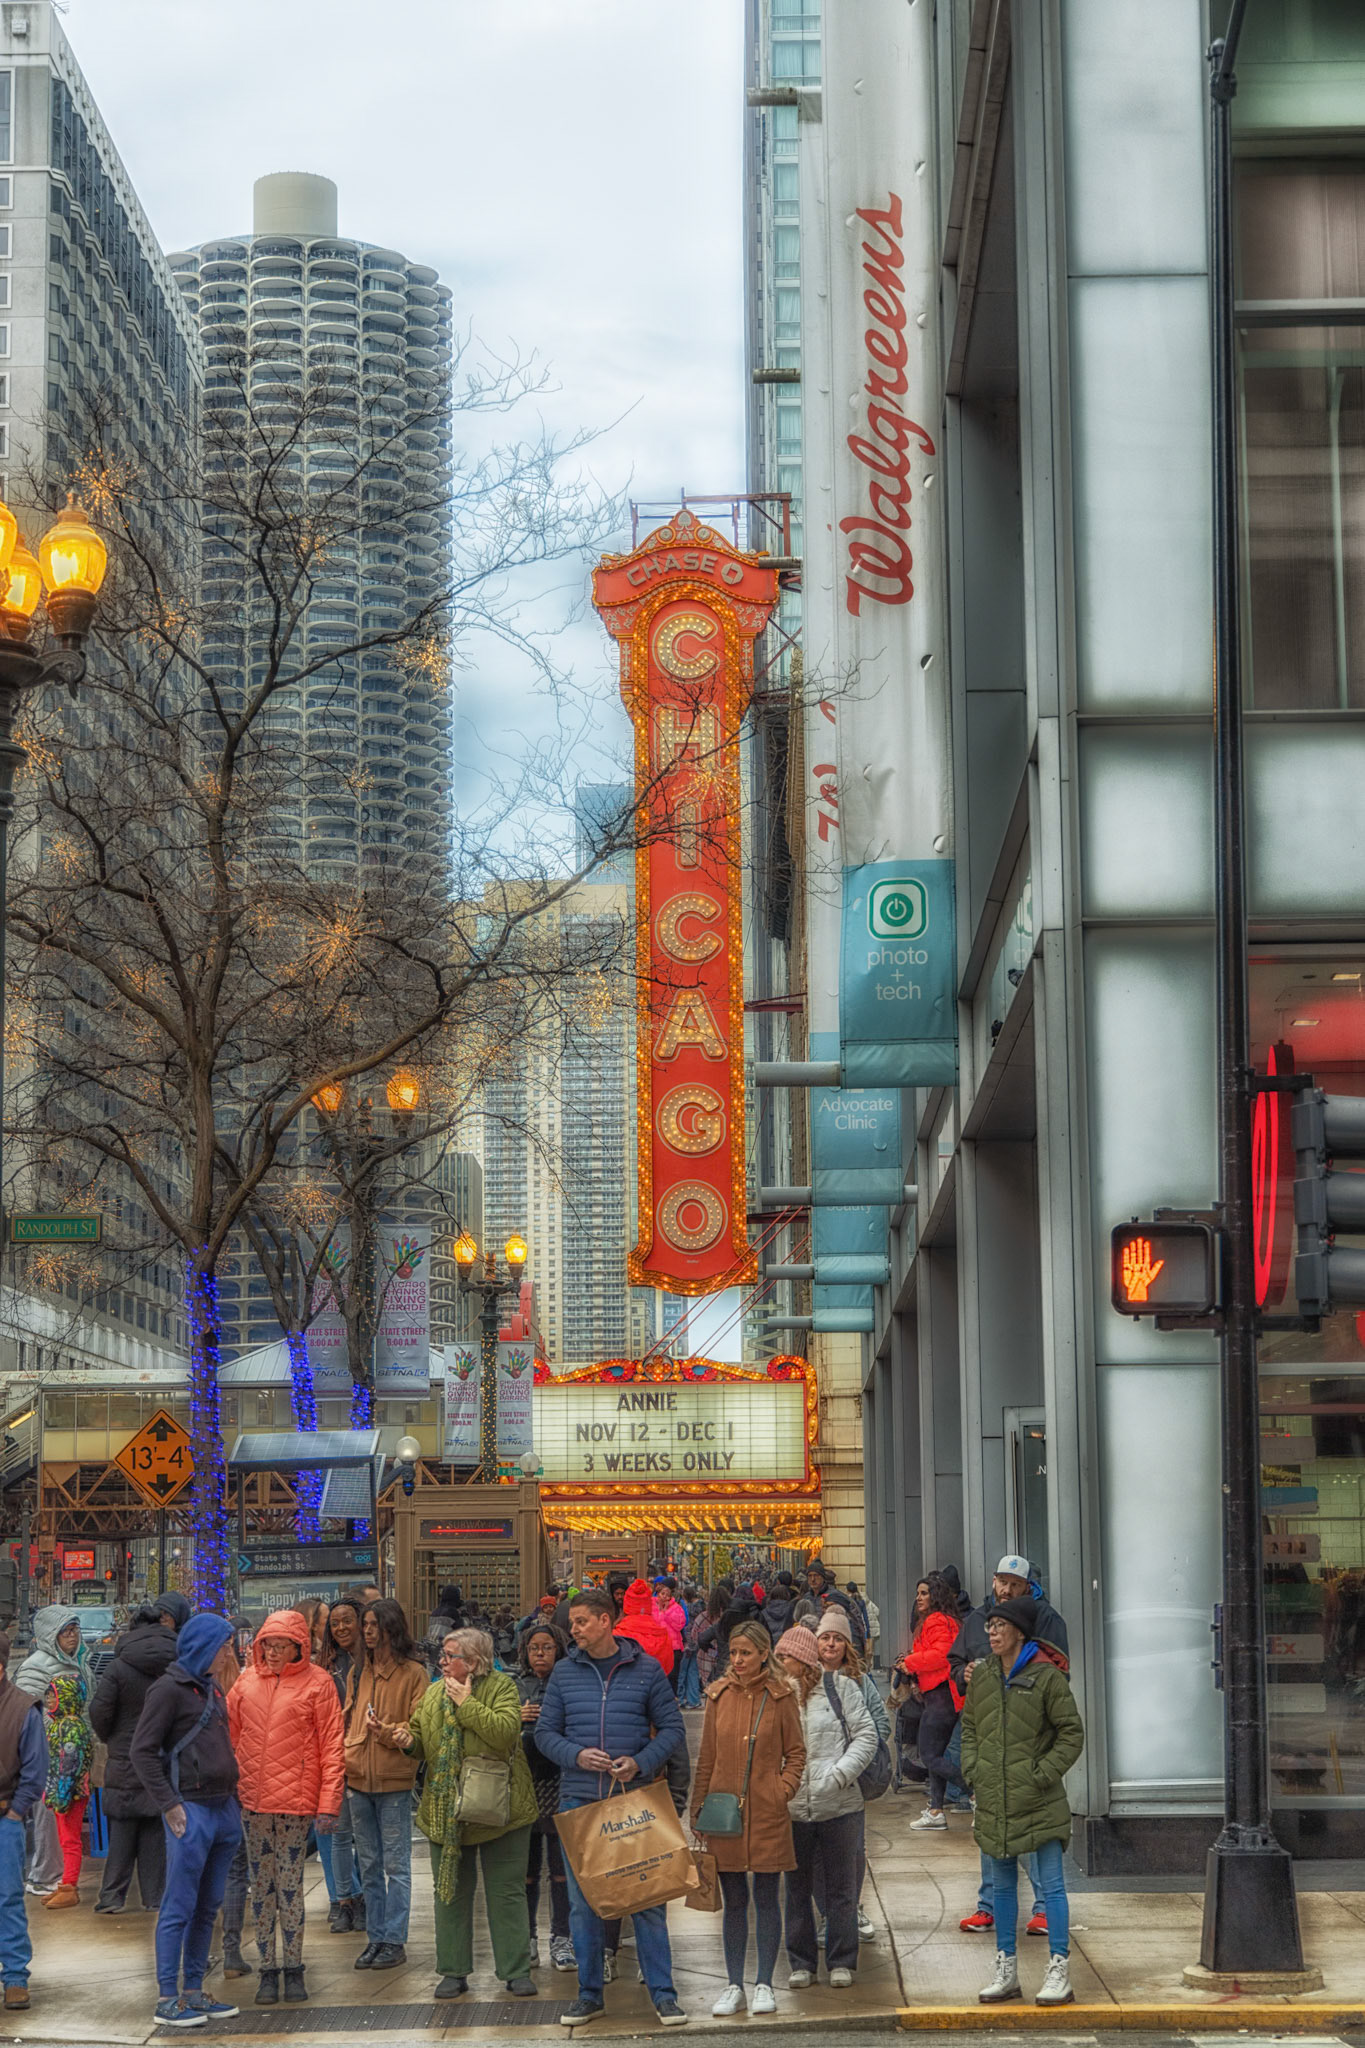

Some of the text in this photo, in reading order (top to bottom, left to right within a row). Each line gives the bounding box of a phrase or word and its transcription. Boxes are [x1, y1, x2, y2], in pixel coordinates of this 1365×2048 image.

[839, 191, 936, 617] Walgreens
[627, 552, 719, 587] CHASE
[651, 610, 729, 1254] CHICAGO
[866, 947, 929, 971] photo
[890, 969, 905, 983] +
[875, 982, 921, 1000] tech
[817, 1097, 894, 1113] Advocate
[834, 1114, 878, 1130] Clinic
[16, 1221, 78, 1234] RANDOLPH
[306, 1328, 323, 1337] TATE
[380, 1328, 426, 1336] STATE STREET
[310, 1339, 327, 1347] 8:00
[387, 1338, 403, 1347] 8:00
[616, 1392, 678, 1411] ANNIE
[576, 1423, 618, 1441] NOV
[630, 1422, 650, 1441] 12
[677, 1421, 716, 1440] DEC
[728, 1421, 734, 1440] 1
[583, 1451, 735, 1472] 3 WEEKS ONLY
[255, 1554, 278, 1562] State
[255, 1562, 305, 1571] Randolph St
[262, 1592, 296, 1608] Happy
[600, 1808, 656, 1837] Marshalls
